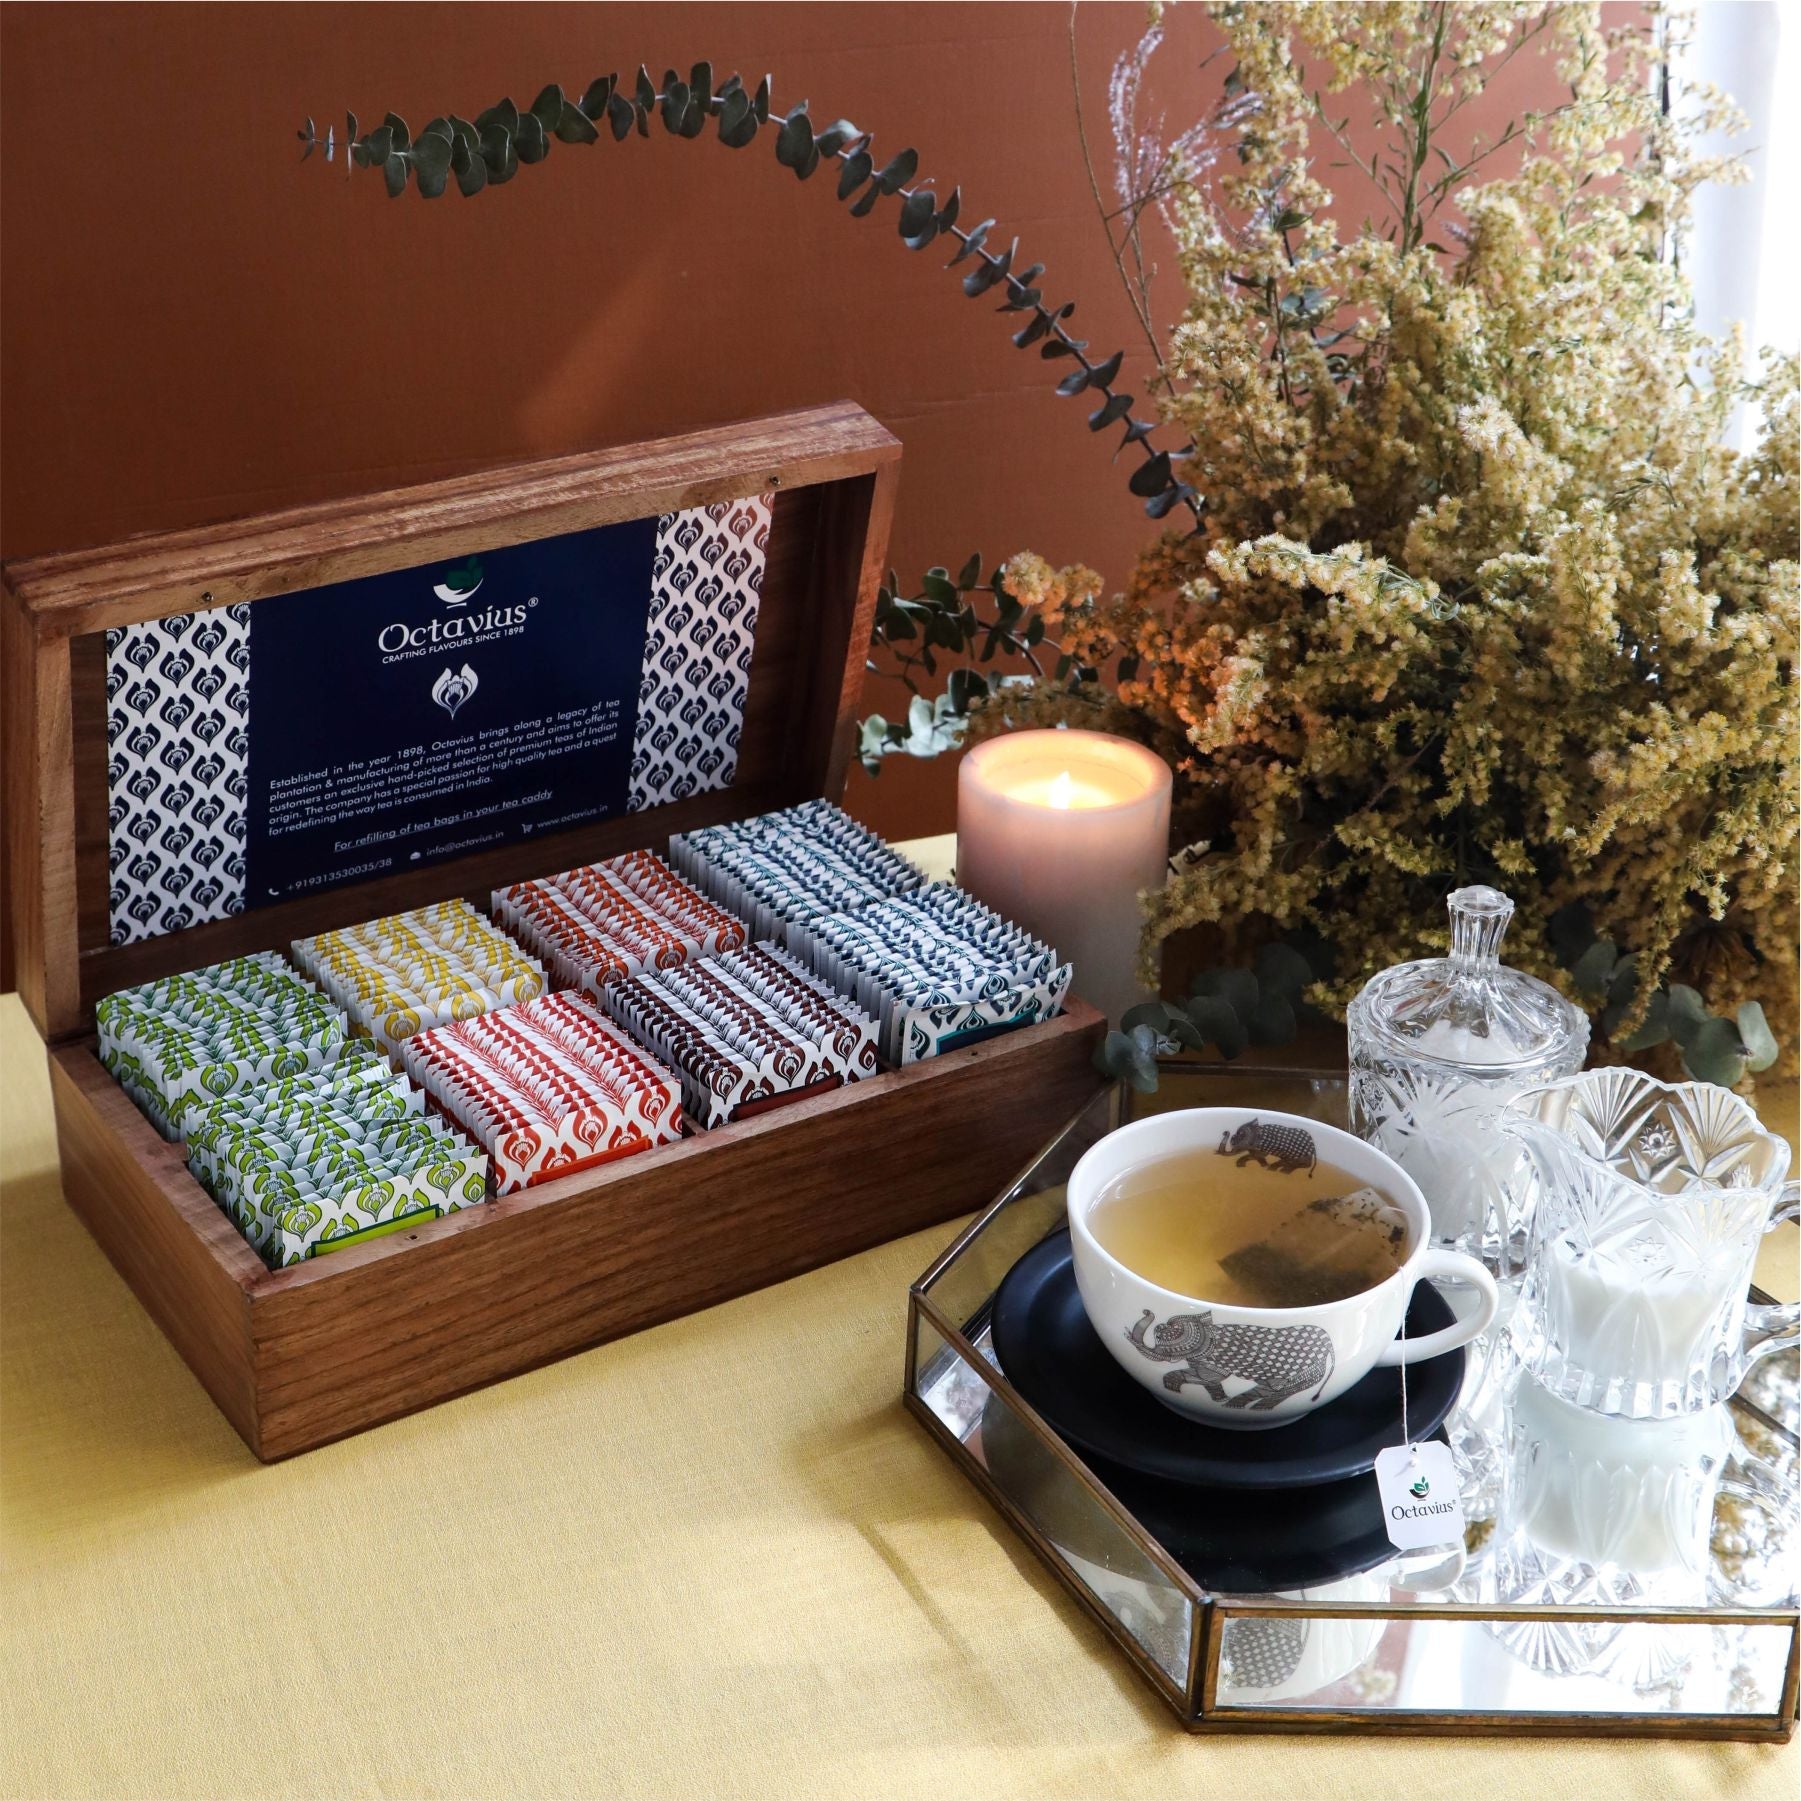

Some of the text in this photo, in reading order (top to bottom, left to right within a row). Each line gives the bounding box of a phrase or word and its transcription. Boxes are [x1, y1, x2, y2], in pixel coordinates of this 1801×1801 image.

[382, 625, 524, 664] CRAFTING FLAVOURS SINCE 1898
[269, 722, 618, 813] customers an exclusive hand-picked selection of premium teas of Indian
[269, 812, 302, 825] origin.
[305, 804, 324, 816] The
[326, 794, 372, 812] company
[374, 787, 392, 799] has
[402, 777, 436, 793] special
[438, 770, 475, 787] passion
[477, 763, 490, 775] for
[492, 759, 513, 771] high
[515, 750, 547, 765] quality
[548, 747, 562, 756] tea
[564, 741, 583, 753] and
[592, 733, 617, 747] quest
[270, 768, 328, 789] Established
[333, 766, 343, 775] in
[349, 759, 364, 771] the
[369, 756, 391, 768] year
[397, 745, 426, 759] 1898,
[431, 735, 474, 751] Octavius
[479, 726, 509, 740] brings
[514, 719, 541, 732] along
[557, 707, 588, 721] legacy
[591, 701, 602, 712] of
[606, 700, 620, 708] tea
[270, 710, 619, 803] plantation & manufacturing of more than a century and aims to offer its
[269, 775, 493, 836] for redefining the way tea is consumed in India.
[334, 789, 553, 850] For refilling of tea bags in your tea caddy
[426, 831, 504, 856] info@octavius.in
[537, 804, 608, 828] www.octavius.in
